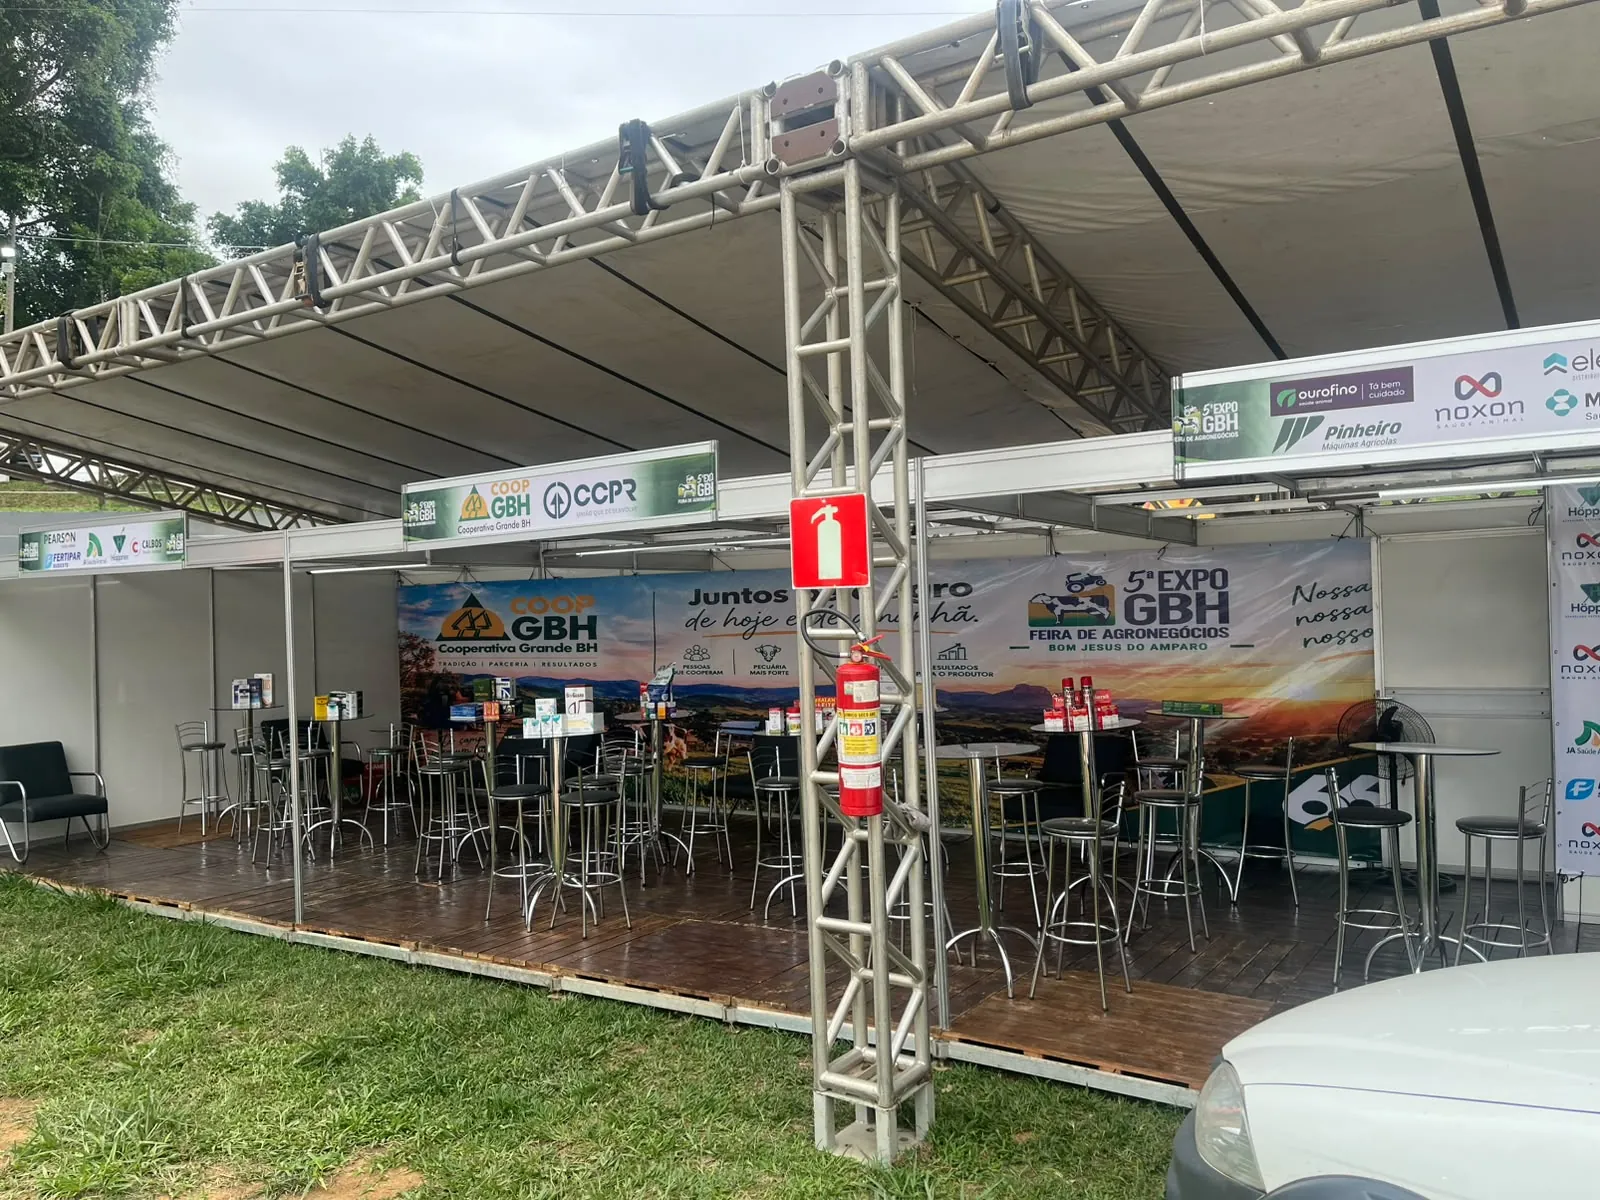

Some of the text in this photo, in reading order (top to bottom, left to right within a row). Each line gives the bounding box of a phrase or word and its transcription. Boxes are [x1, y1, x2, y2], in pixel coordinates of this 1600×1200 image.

[1571, 348, 1600, 372] el
[1298, 384, 1358, 400] ourofino
[1381, 380, 1401, 389] bem
[1369, 389, 1405, 400] cuidado
[1213, 401, 1238, 414] EXPO
[1434, 400, 1525, 422] noxon
[1202, 413, 1239, 434] GBH
[1324, 421, 1402, 441] Pinheiro
[1321, 437, 1398, 452] Máquinas Agrícolas
[490, 480, 530, 497] COOP
[574, 478, 637, 507] CCPR
[419, 508, 436, 522] GBH
[490, 496, 531, 520] GBH
[457, 518, 531, 535] Cooperativa Grande BH
[44, 532, 77, 545] PEARSON
[53, 551, 81, 562] FERTIPAR
[1562, 551, 1600, 560] nox
[1124, 568, 1229, 593] 5ª EXPO
[688, 587, 789, 606] Juntos
[1291, 582, 1373, 606] Nossa
[510, 595, 597, 615] COOP
[1124, 591, 1230, 626] GBH
[1295, 603, 1373, 627] nossa
[511, 615, 598, 641] GBH
[685, 608, 713, 629] de
[723, 608, 780, 640] hoje
[786, 614, 799, 626] e
[1029, 625, 1230, 641] FEIRA DE AGRONEGÓCIOS
[1303, 627, 1374, 649] nosso
[439, 643, 598, 656] Cooperativa Grande BH
[1048, 642, 1208, 652] BOM JESUS DO AMPARO
[438, 660, 477, 669] TRADIÇÃO
[1561, 665, 1600, 674] nox
[1566, 747, 1576, 755] JA
[1577, 747, 1597, 755] Saúde
